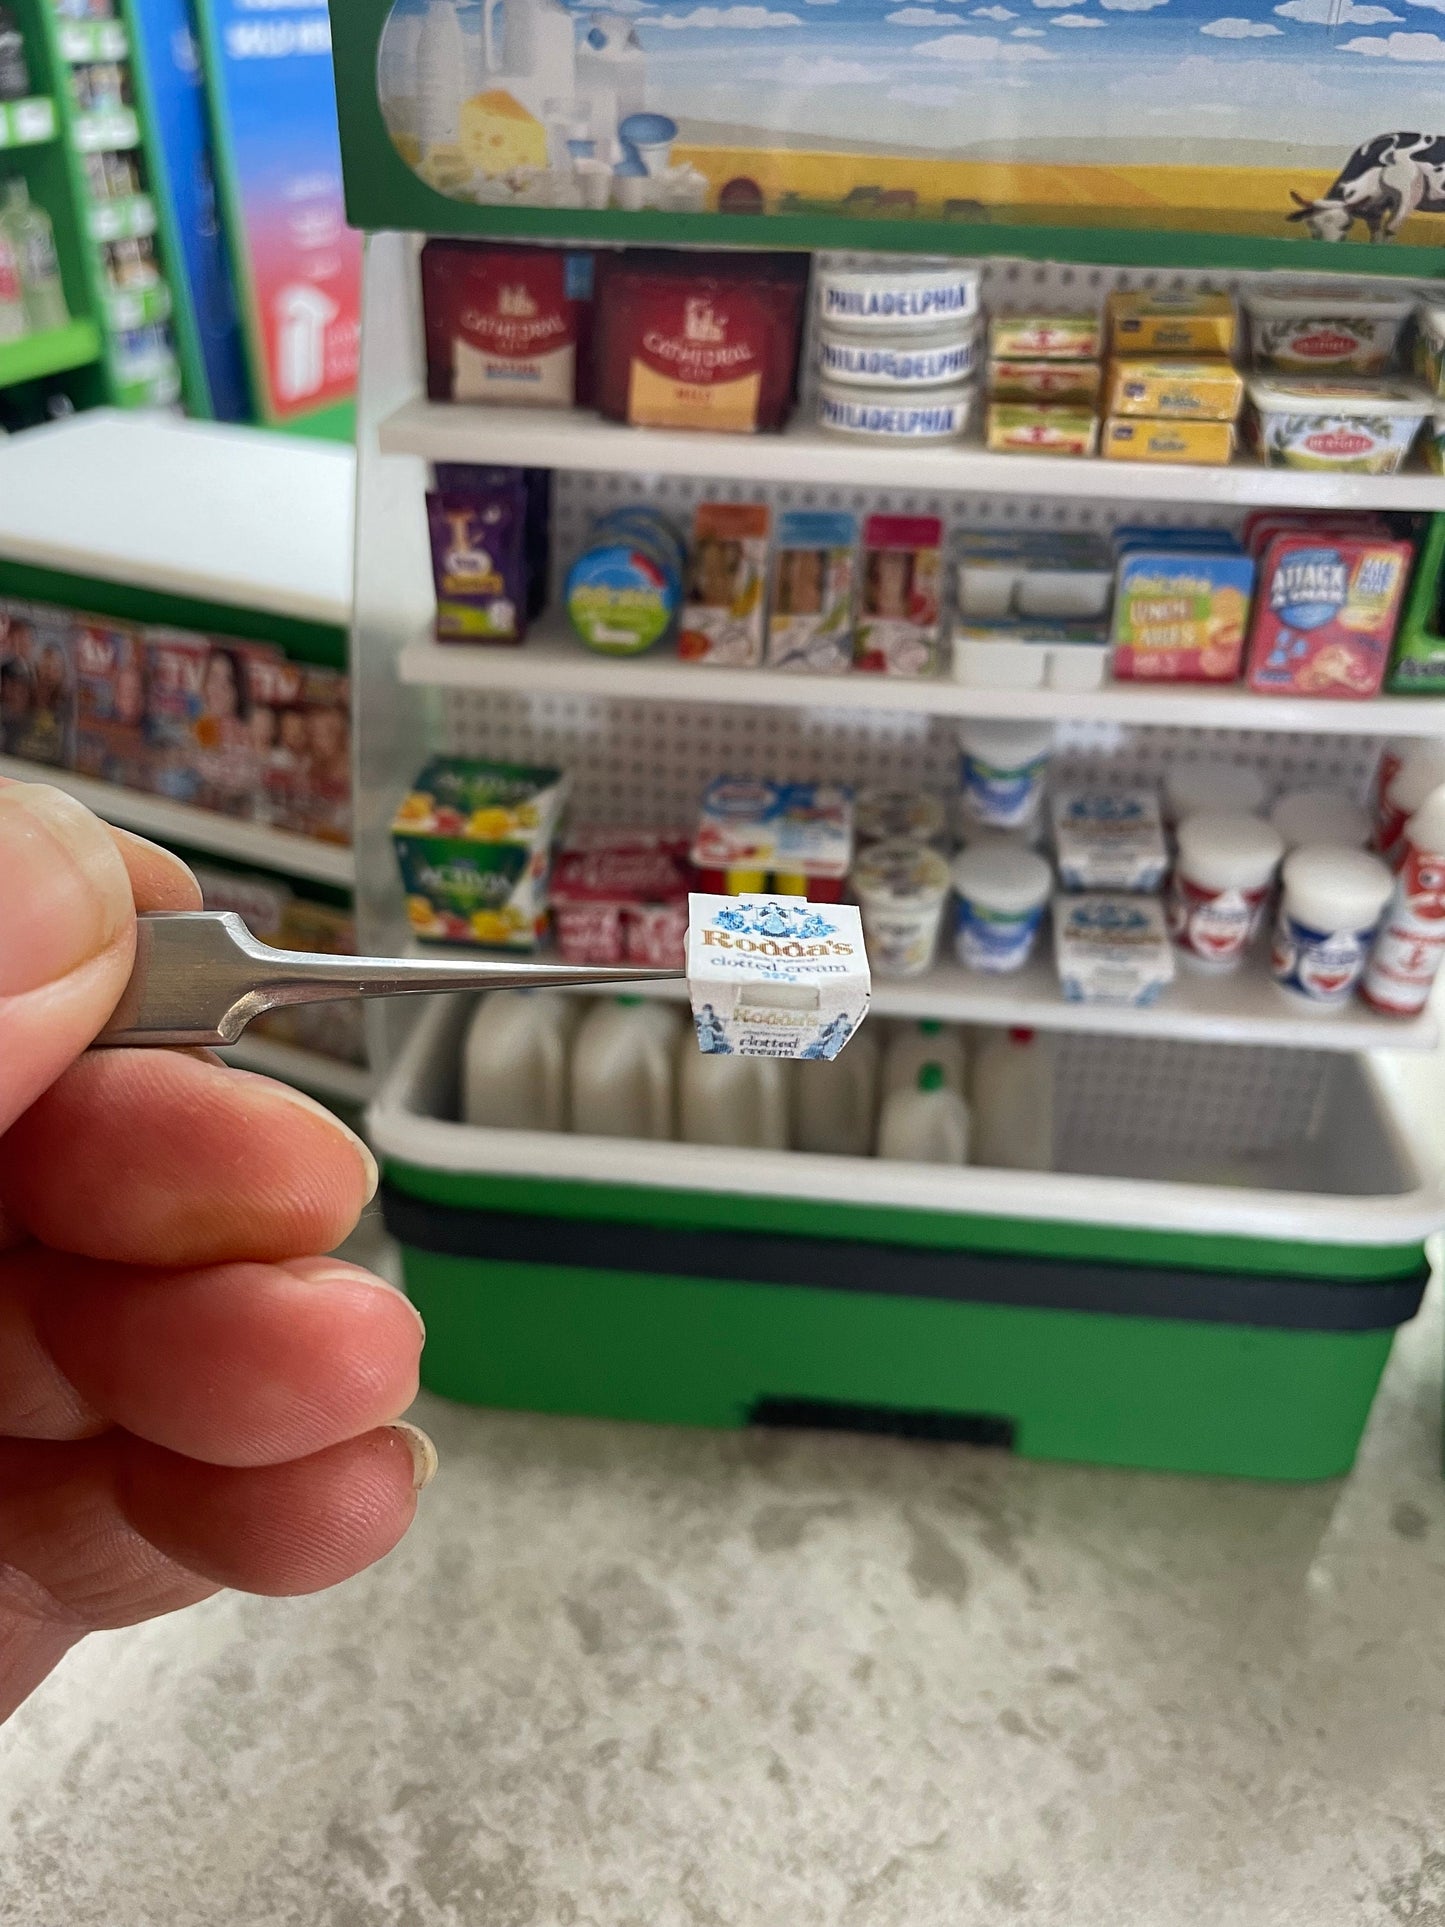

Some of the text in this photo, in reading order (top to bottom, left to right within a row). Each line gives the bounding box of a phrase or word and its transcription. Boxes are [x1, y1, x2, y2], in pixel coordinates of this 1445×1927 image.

[828, 284, 966, 316] PHILADELPHIA
[642, 331, 755, 368] CATHEDRAL
[821, 399, 954, 433] PHILADELPHIA
[1271, 563, 1347, 593] ATTACK
[702, 929, 854, 957] Rodda's
[710, 955, 777, 972] clotted
[785, 963, 849, 974] cream
[739, 1035, 800, 1049] clotted
[740, 1048, 795, 1057] cream
